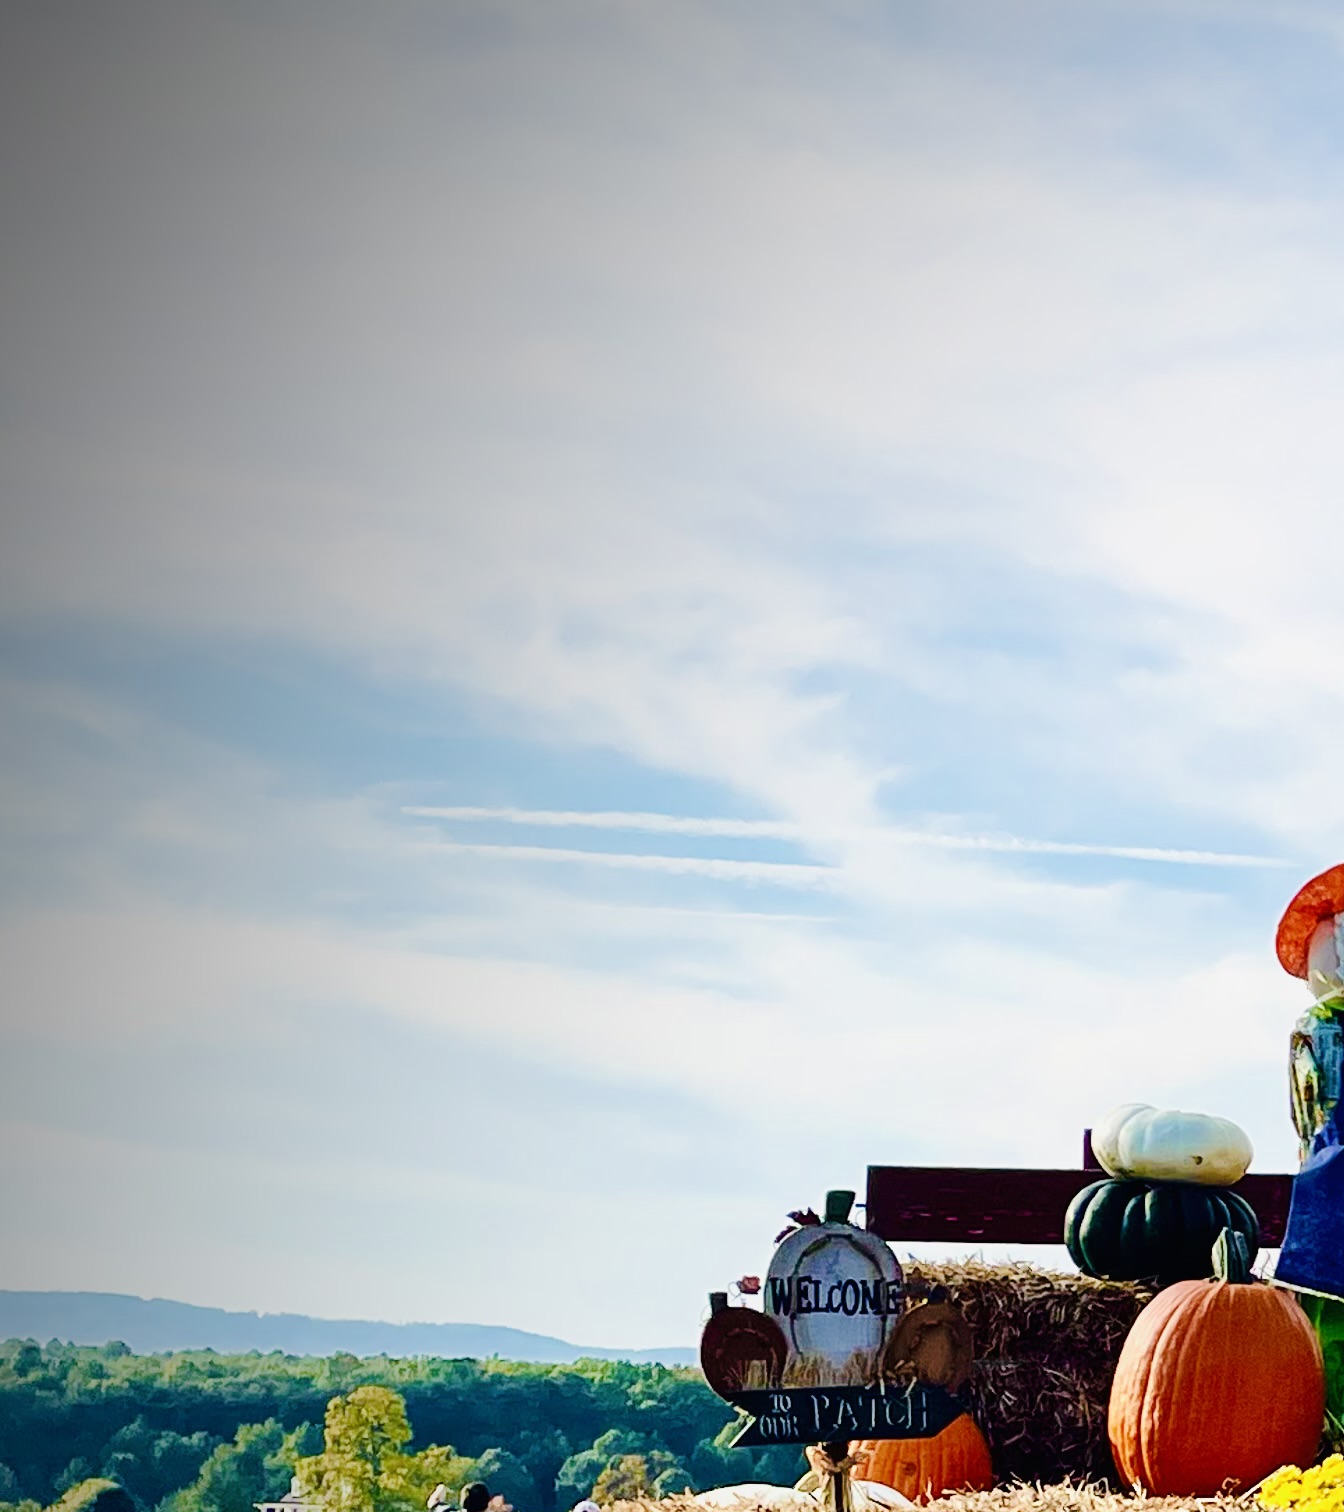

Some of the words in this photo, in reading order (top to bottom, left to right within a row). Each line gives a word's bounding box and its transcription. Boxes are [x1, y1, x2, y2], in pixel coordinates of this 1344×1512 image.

[768, 1275, 901, 1317] WELCOME
[769, 1393, 792, 1413] TO
[810, 1391, 928, 1431] PATCH
[758, 1413, 800, 1439] OUR
